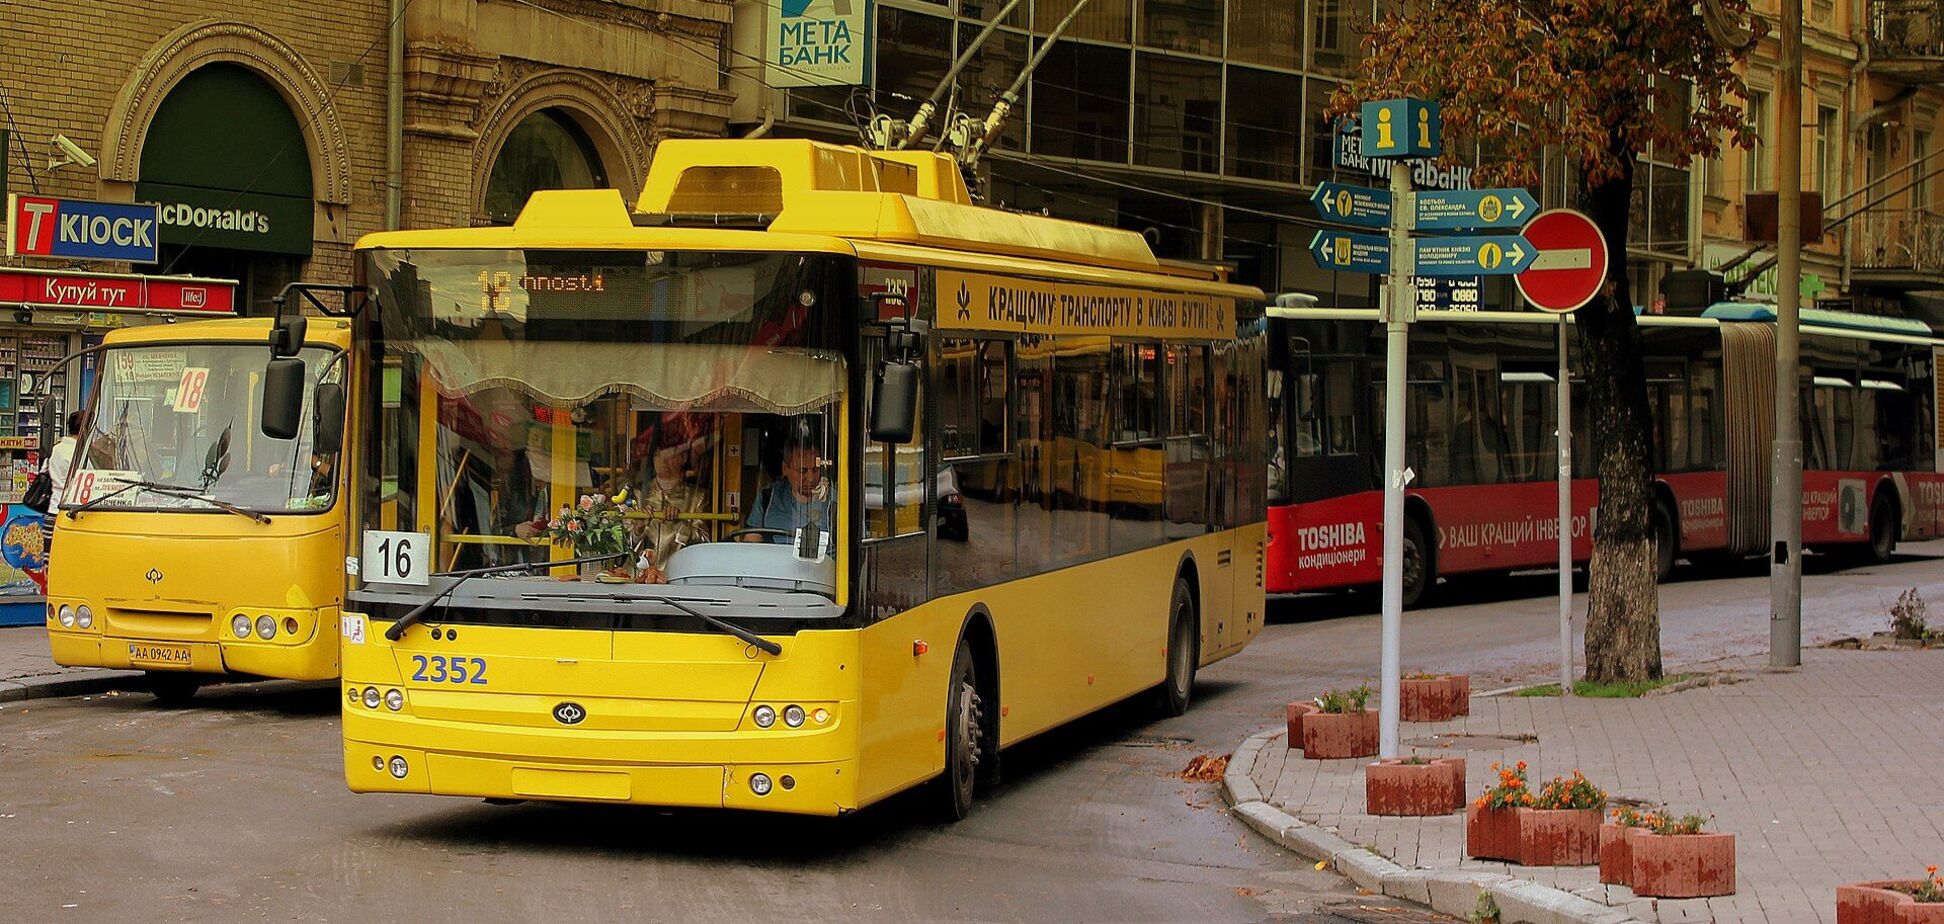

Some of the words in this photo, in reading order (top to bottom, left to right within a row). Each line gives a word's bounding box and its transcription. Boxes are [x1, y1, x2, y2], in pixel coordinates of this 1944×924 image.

[780, 20, 851, 46] МЕТА
[779, 45, 851, 66] БАНК
[1341, 134, 1363, 155] МЕТ
[1341, 152, 1370, 171] БАНК
[45, 277, 97, 304] Купуй
[101, 287, 127, 307] тут
[988, 285, 1056, 330] КРАЩОМУ
[1060, 294, 1132, 328] ТРАНСПОРТУ
[1136, 297, 1143, 326] В
[1149, 298, 1177, 329] КИЄВІ
[180, 371, 206, 409] 18
[71, 472, 96, 505] 18
[1681, 496, 1724, 517] TOSHIBA
[1297, 521, 1366, 551] TOSHIBA
[1450, 525, 1478, 547] ВАШ
[1481, 515, 1534, 548] КРАЩИЙ
[1536, 517, 1587, 542] ІНВЕОР
[378, 537, 412, 578] 16
[1298, 546, 1366, 570] кондиціонери
[135, 647, 149, 659] AA
[150, 648, 172, 661] 0942
[174, 649, 188, 662] AA
[412, 655, 488, 685] 2352
